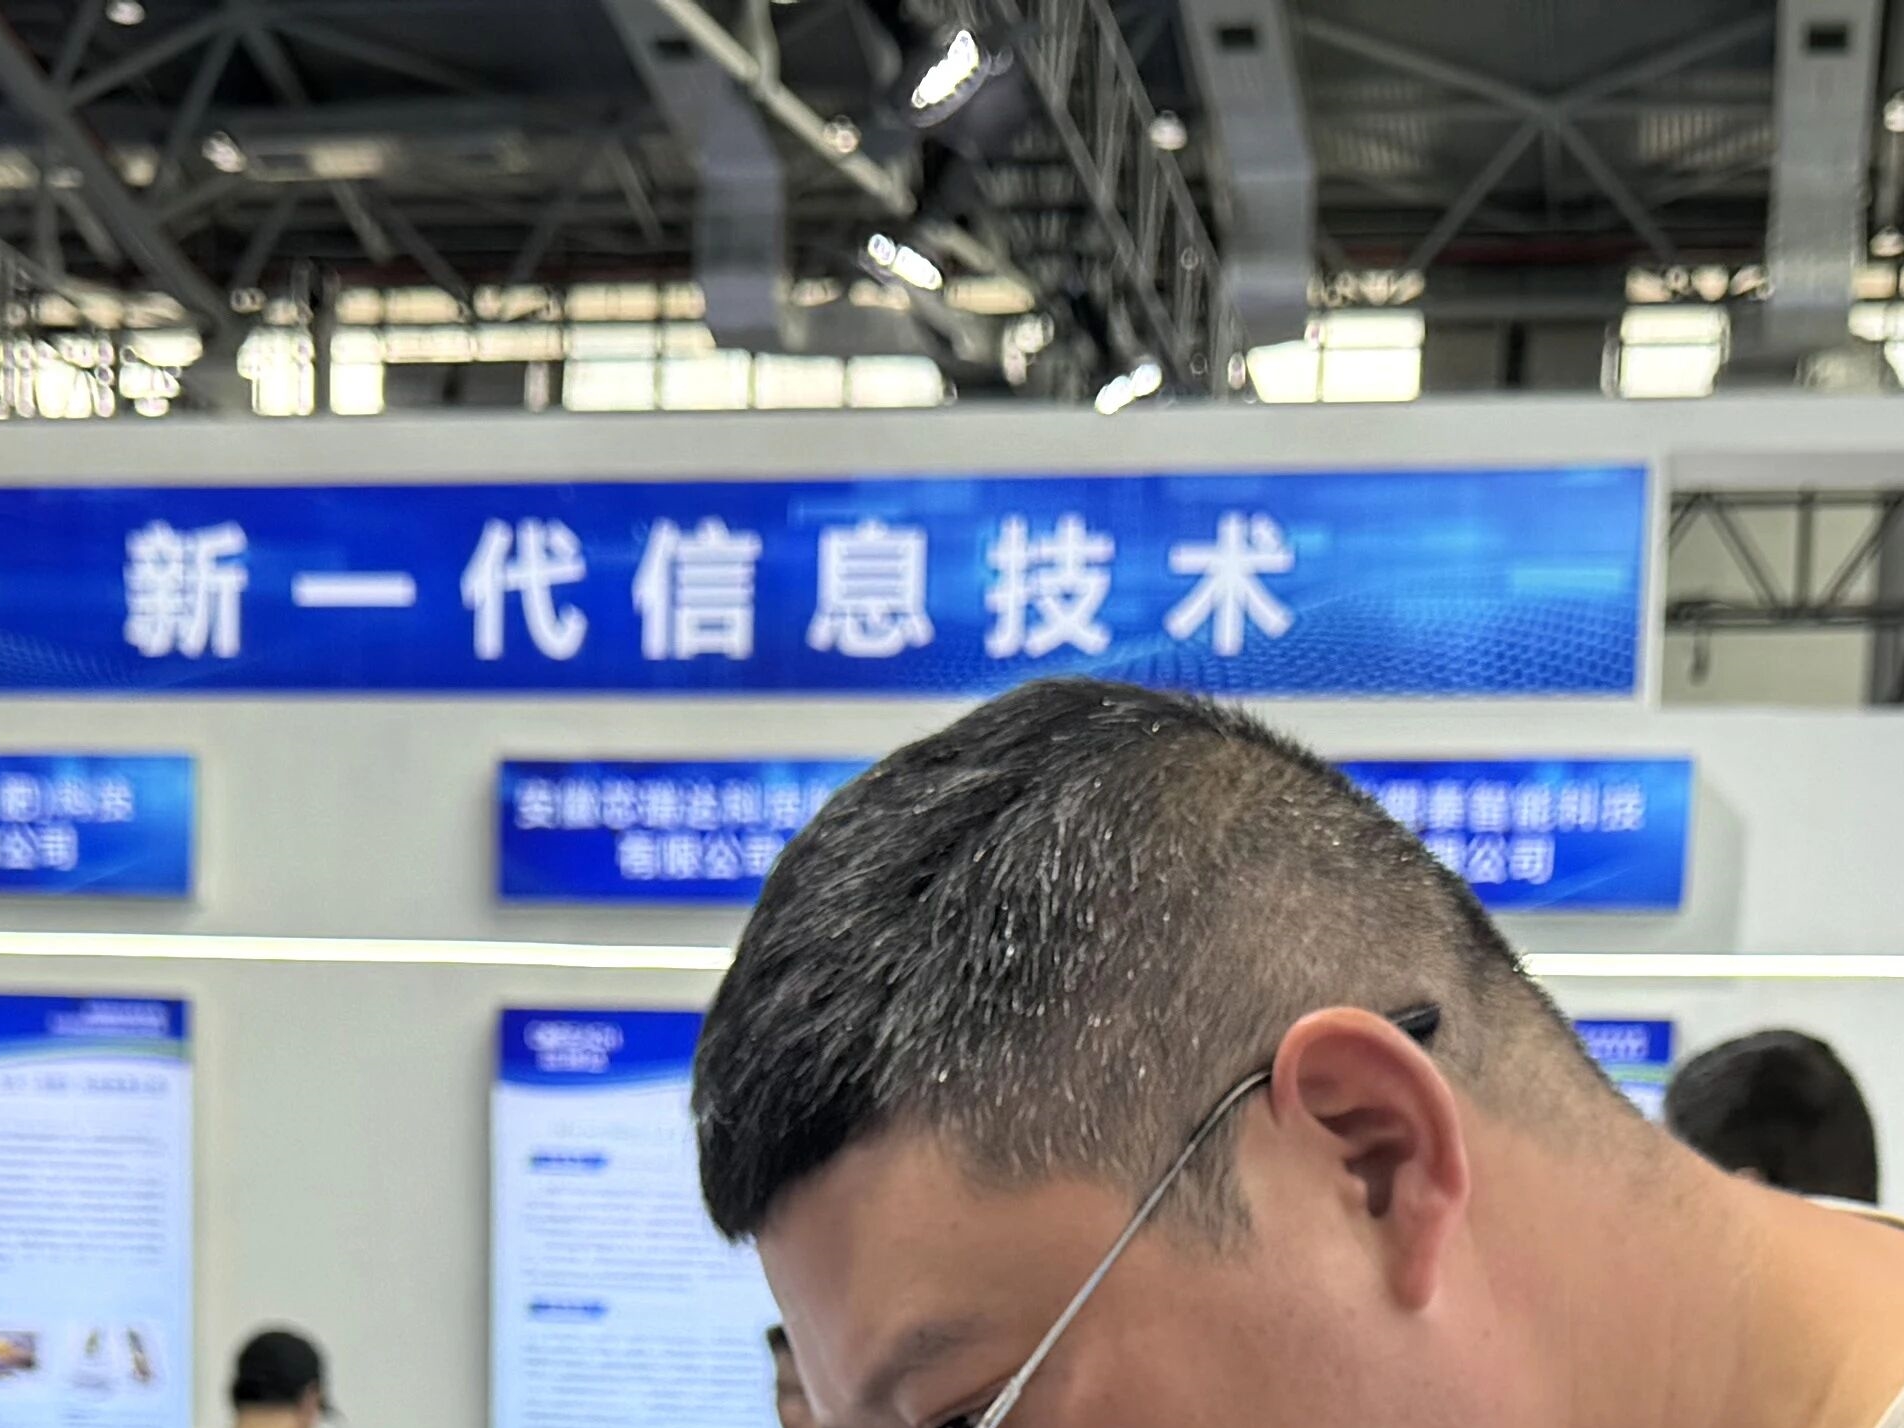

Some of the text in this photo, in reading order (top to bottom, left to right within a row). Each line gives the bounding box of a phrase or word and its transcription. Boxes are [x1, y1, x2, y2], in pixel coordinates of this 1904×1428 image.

[122, 513, 1296, 662] 新一代信息技术
